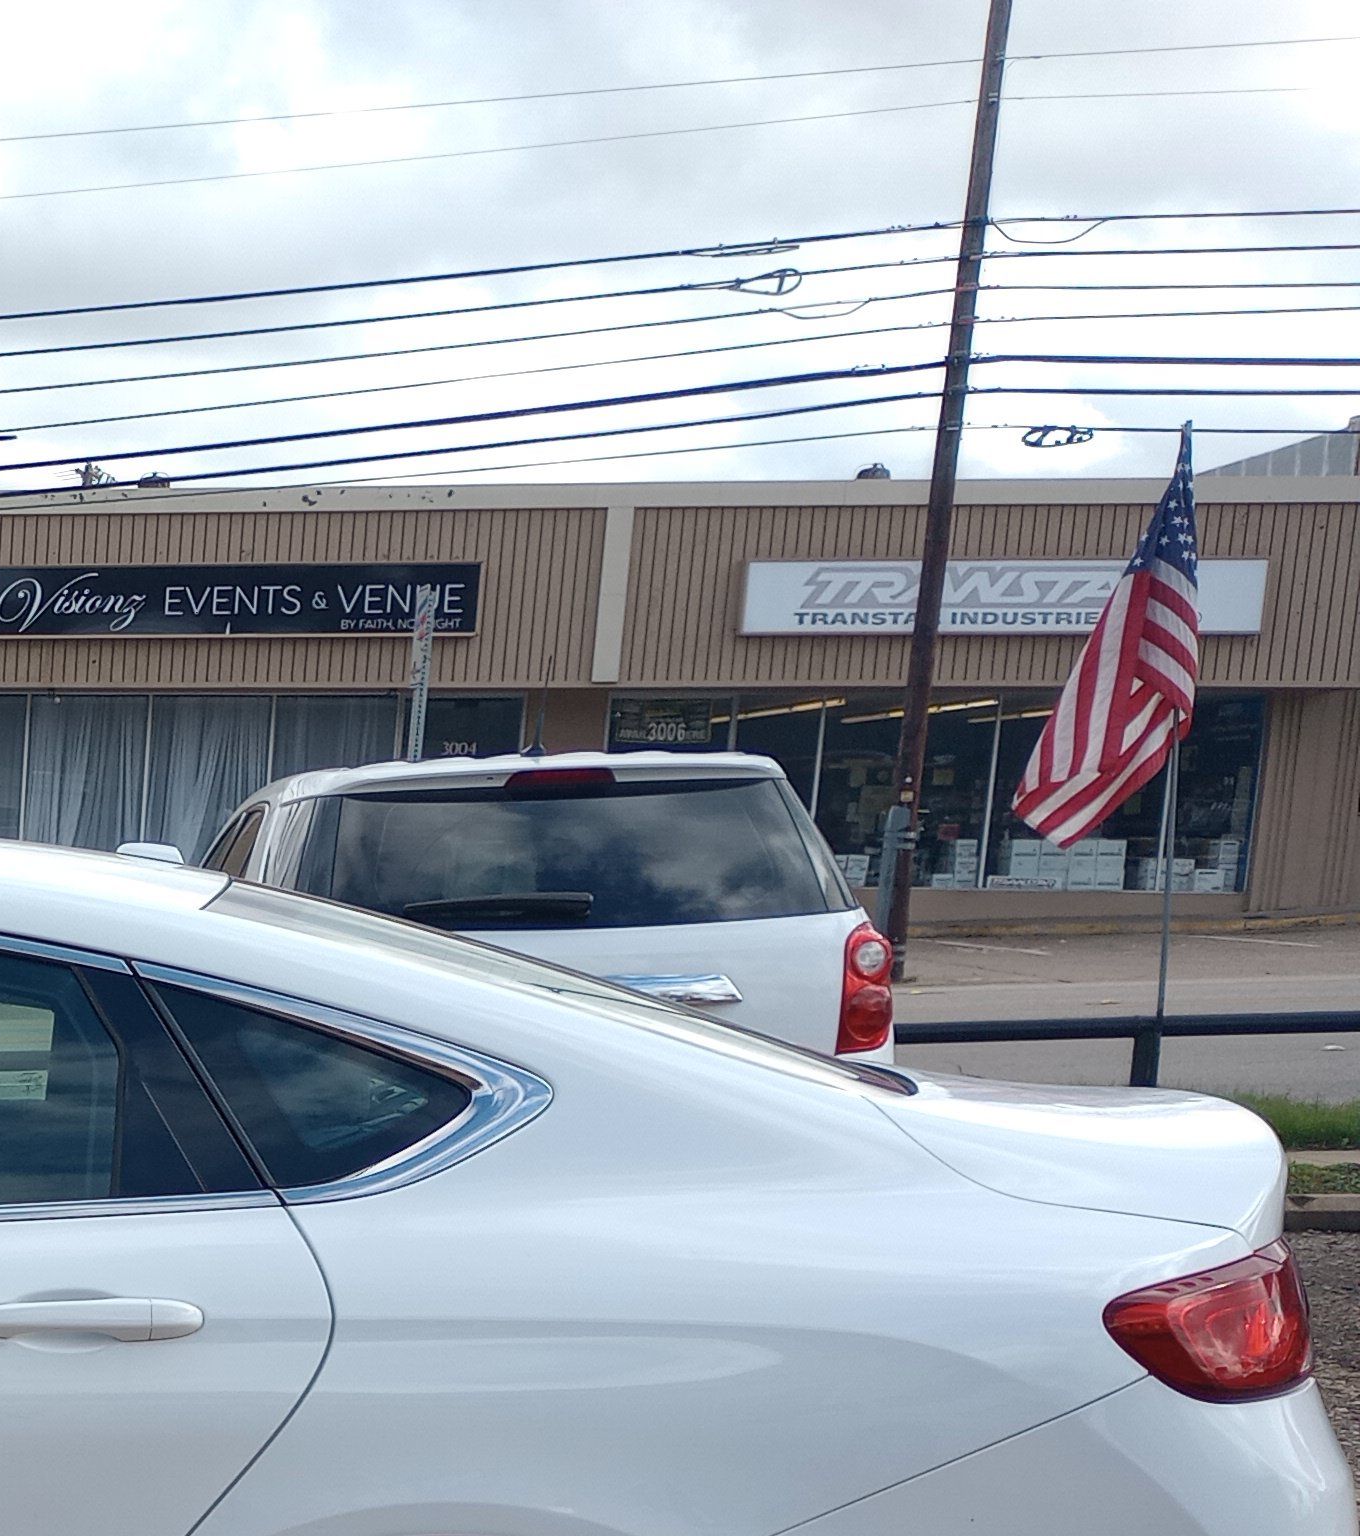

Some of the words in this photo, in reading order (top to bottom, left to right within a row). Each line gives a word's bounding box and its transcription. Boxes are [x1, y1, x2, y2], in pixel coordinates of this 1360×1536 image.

[164, 585, 301, 616] EVENTS
[312, 591, 329, 609] &
[340, 619, 356, 630] BY
[647, 722, 687, 741] 3006
[441, 741, 478, 756] 3004
